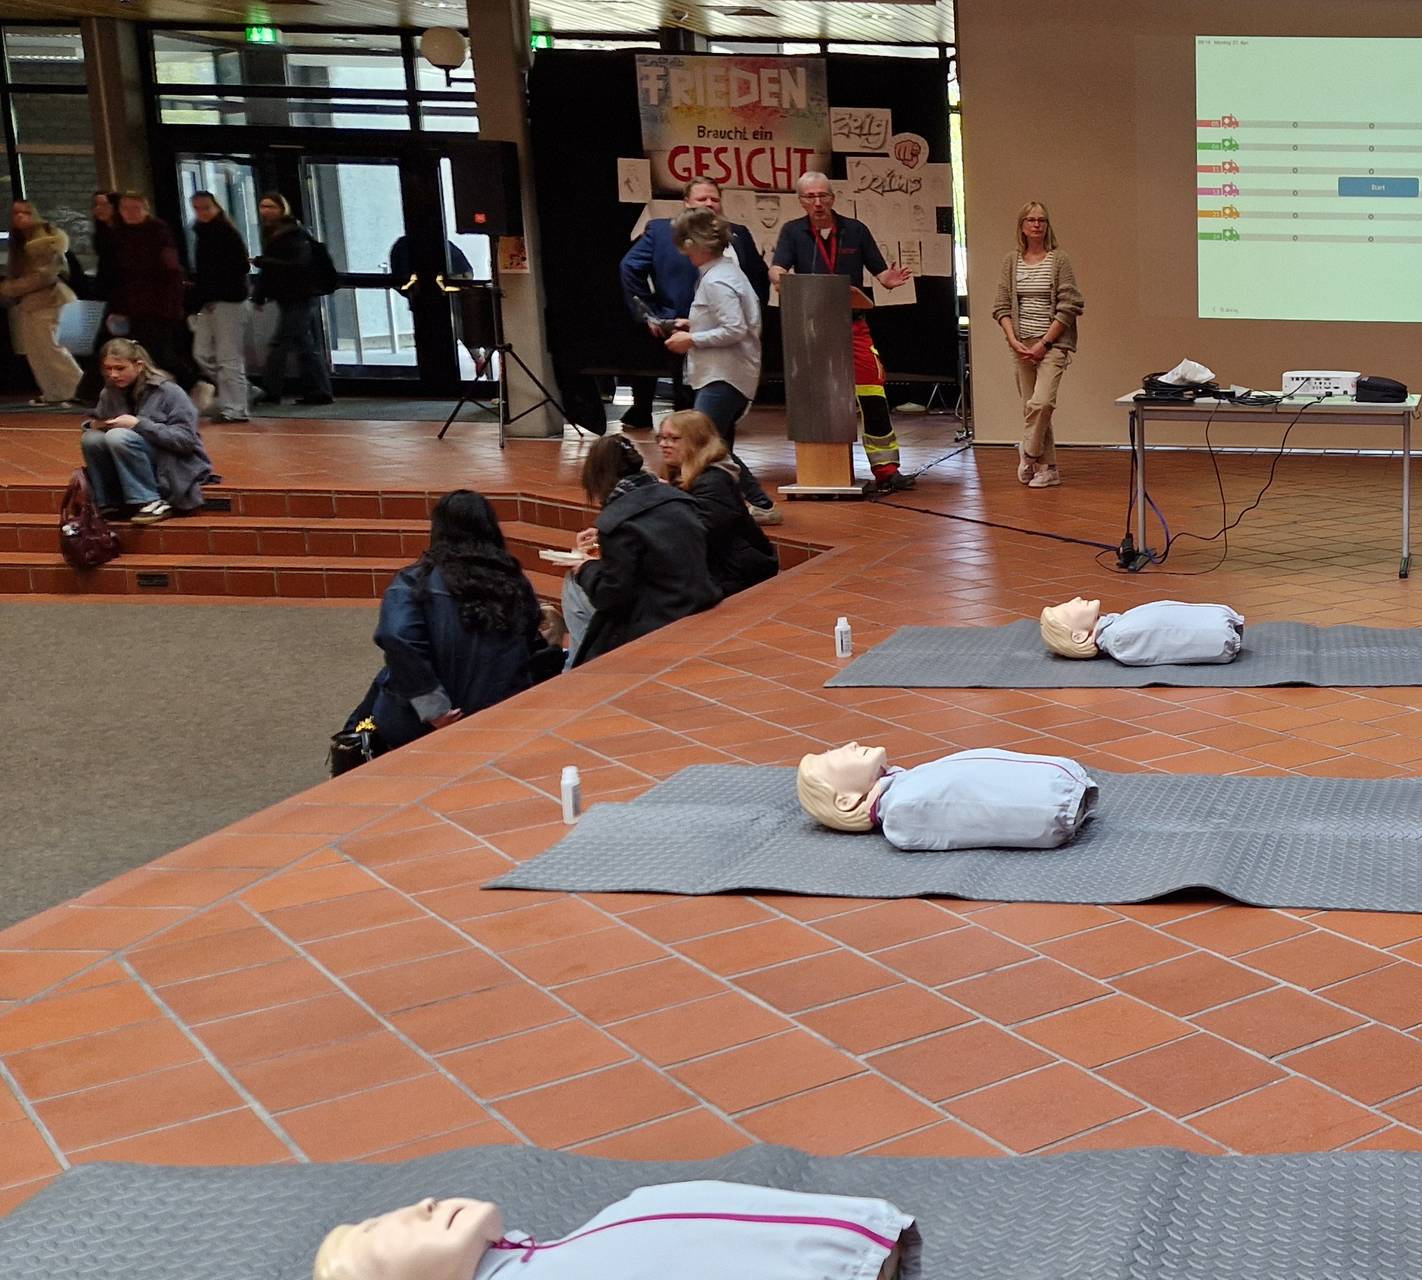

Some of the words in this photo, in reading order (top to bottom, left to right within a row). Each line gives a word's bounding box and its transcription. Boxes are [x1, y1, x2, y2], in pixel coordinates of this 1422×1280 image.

[640, 66, 807, 109] FRIEDEN
[697, 125, 749, 140] Braucht
[752, 126, 773, 140] ein
[667, 145, 817, 190] GESICHT
[1371, 183, 1386, 191] Start
